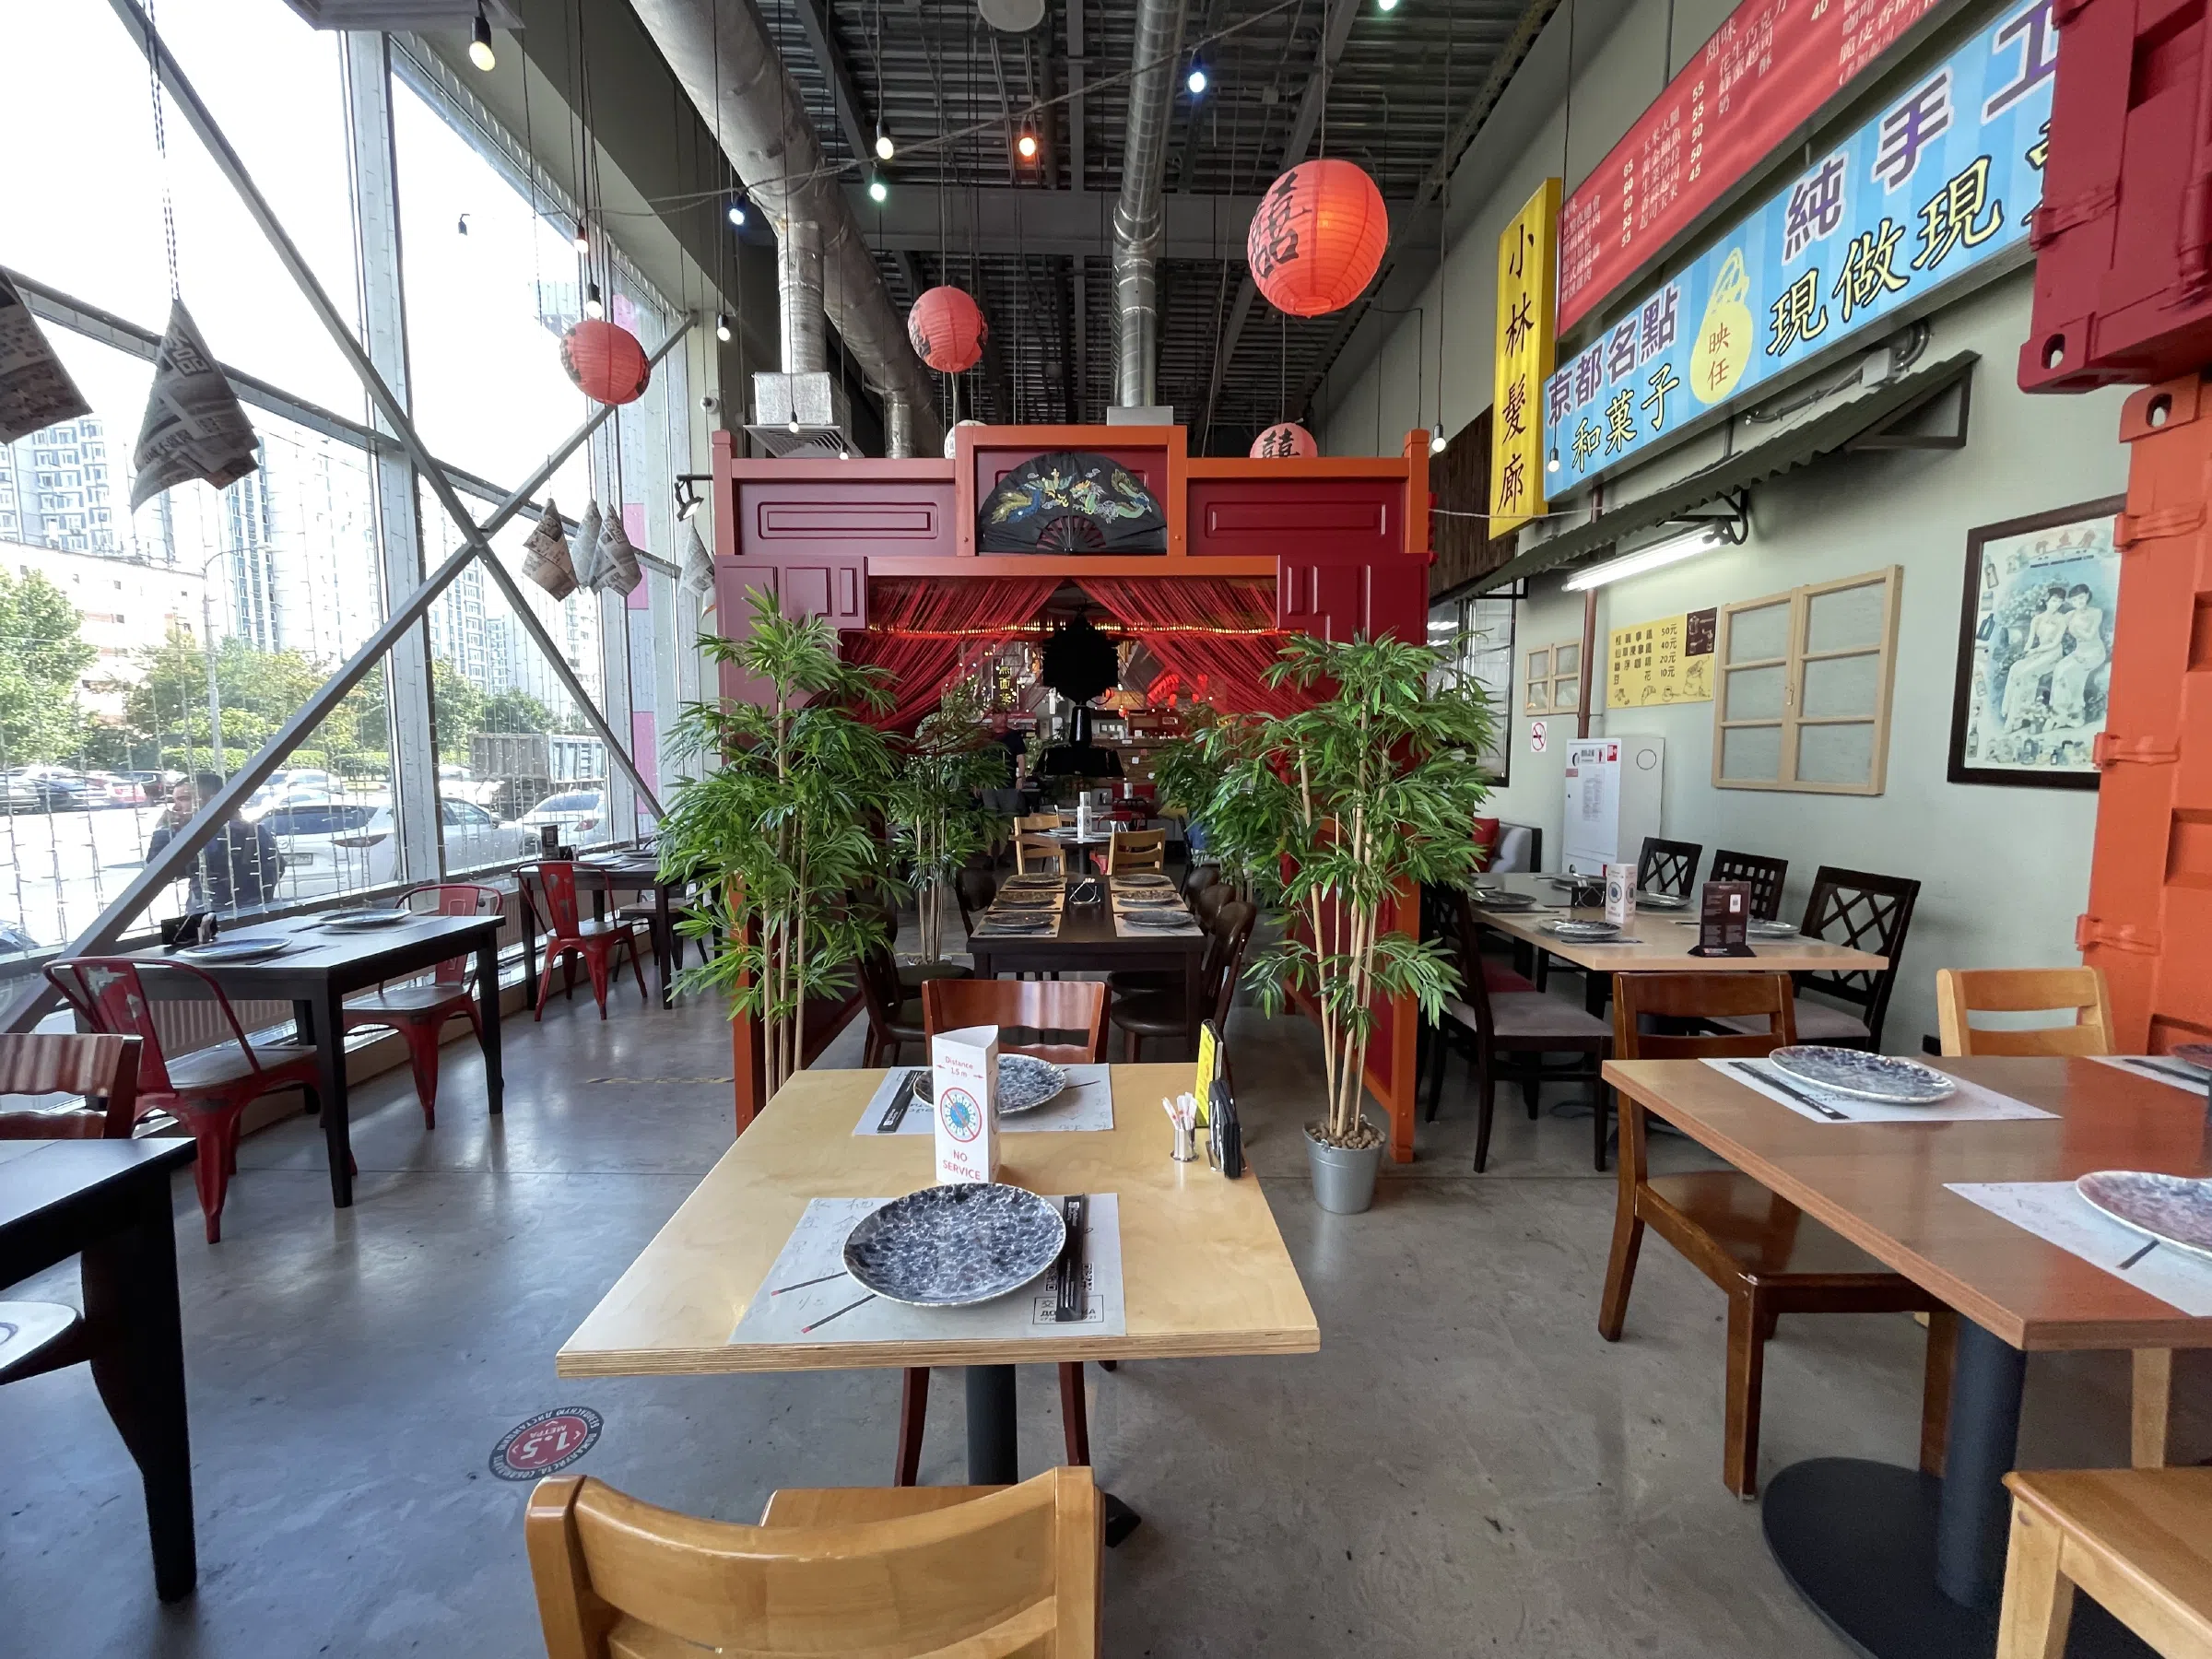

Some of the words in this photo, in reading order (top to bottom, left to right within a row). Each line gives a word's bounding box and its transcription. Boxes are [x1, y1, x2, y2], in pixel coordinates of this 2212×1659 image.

[1810, 0, 1828, 21] 40
[1692, 80, 1704, 102] 55
[1692, 100, 1704, 124] 55
[1691, 123, 1703, 143] 50
[1783, 0, 2058, 263] 純手工
[1690, 143, 1702, 164] 50
[1688, 161, 1701, 182] 45
[1623, 177, 1633, 195] 60
[1623, 195, 1633, 212] 60
[1622, 213, 1632, 230] 55
[1621, 230, 1631, 248] 55
[1766, 120, 2051, 358] 現做現
[1547, 286, 1680, 427] 京都名點
[1497, 224, 1535, 514] 小林髮廊
[1572, 364, 1680, 473] 和菓子
[1661, 623, 1677, 636] 50元
[1661, 637, 1677, 650] 40元
[1659, 652, 1676, 664] 20元
[1660, 665, 1675, 677] 10元
[945, 1056, 973, 1070] Distance
[953, 1149, 968, 1162] NO
[943, 1160, 981, 1181] SERVICE
[530, 1424, 567, 1439] МЕТРА
[520, 1431, 571, 1460] 1.5
